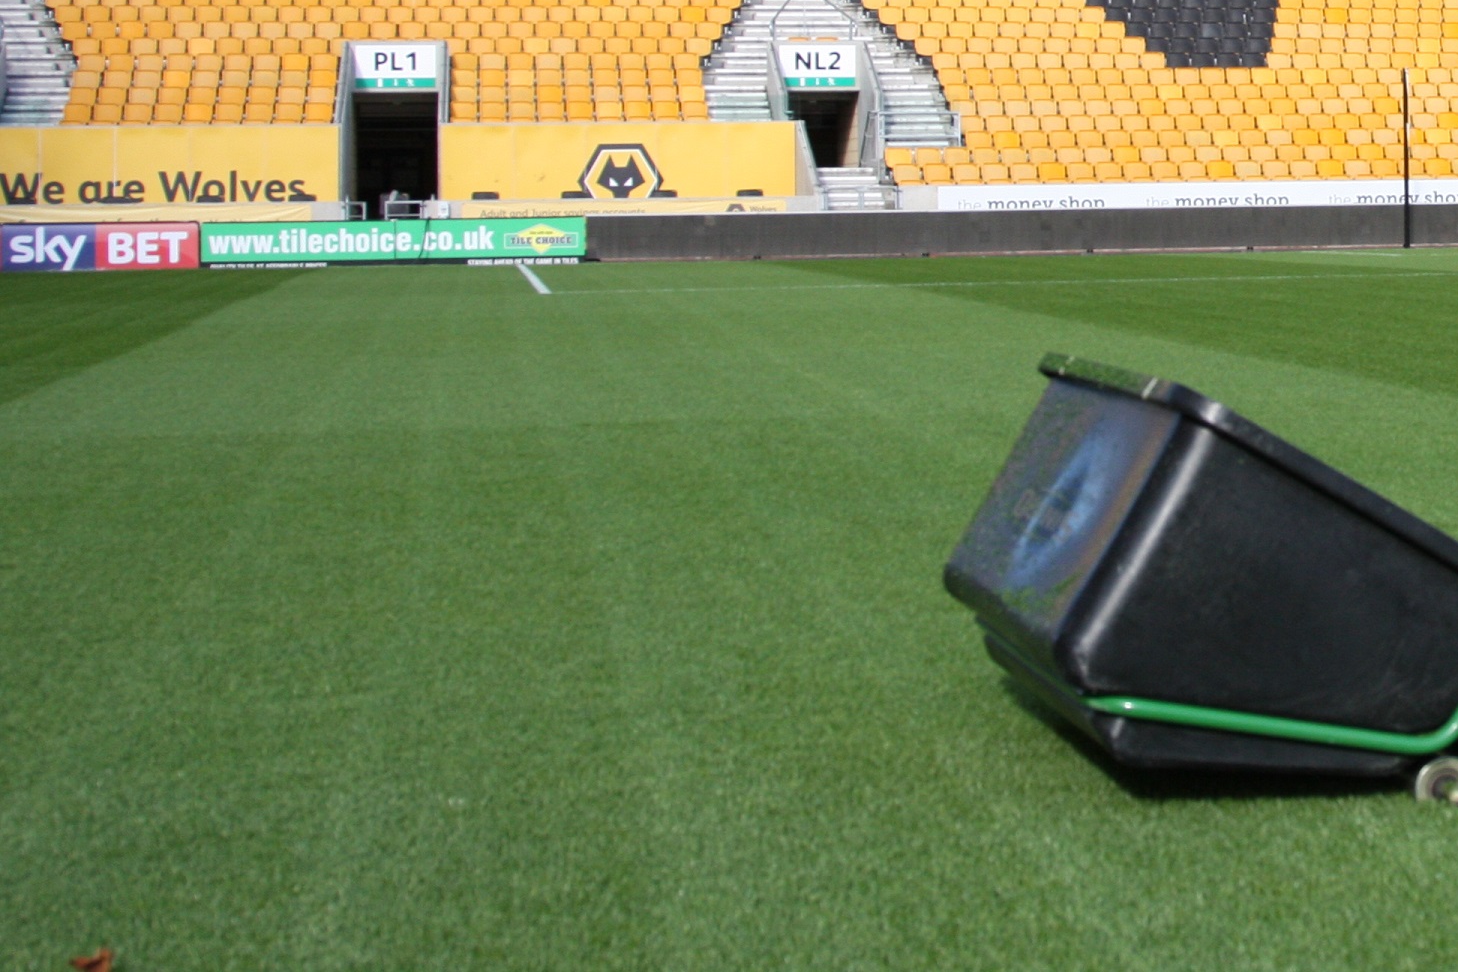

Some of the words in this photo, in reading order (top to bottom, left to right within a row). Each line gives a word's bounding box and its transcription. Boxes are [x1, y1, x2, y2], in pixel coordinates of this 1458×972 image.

[374, 52, 416, 71] PL1
[794, 52, 841, 70] NL2
[0, 172, 65, 205] We
[78, 179, 146, 205] are
[158, 170, 307, 204] Wolves
[10, 227, 87, 270] sky
[107, 230, 188, 265] BET
[208, 225, 494, 255] www.tilechoice.co.uk
[510, 236, 532, 245] TILE
[535, 236, 572, 245] CHOICE
